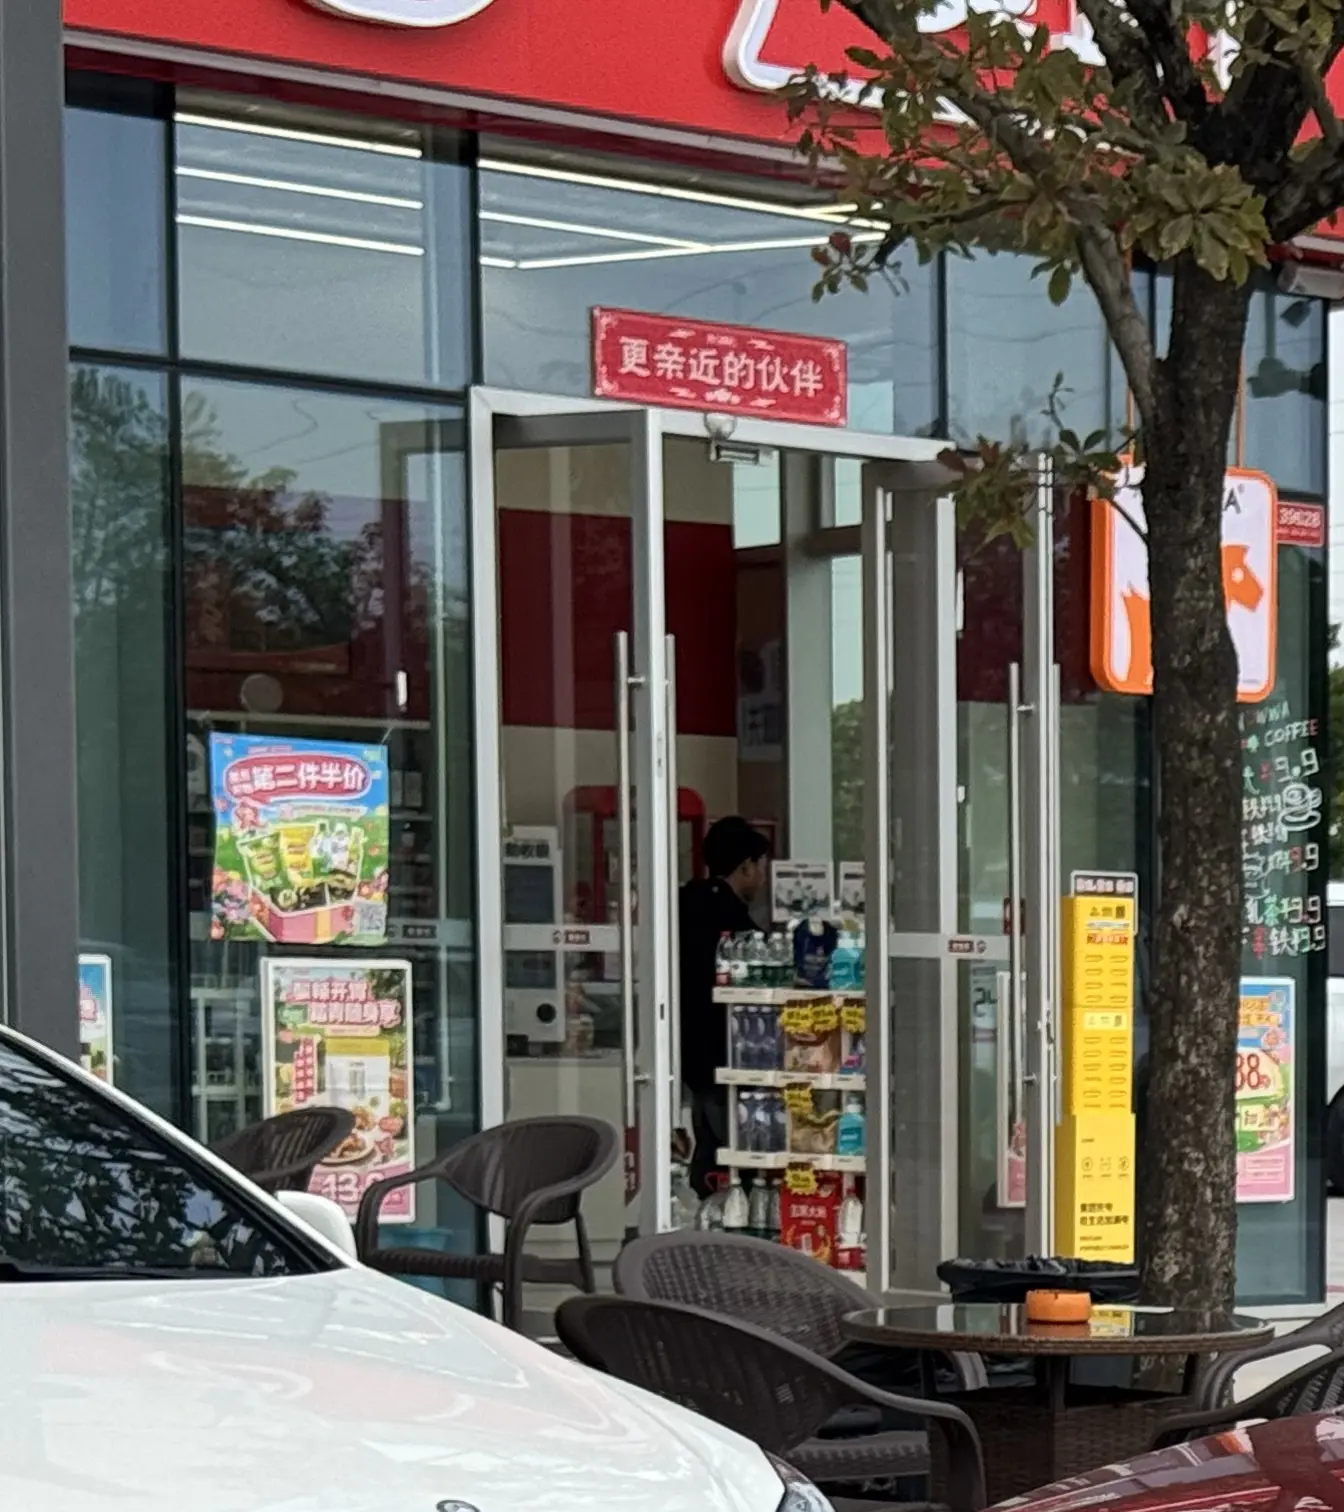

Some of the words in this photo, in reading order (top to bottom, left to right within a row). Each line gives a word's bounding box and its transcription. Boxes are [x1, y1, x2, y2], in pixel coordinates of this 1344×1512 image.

[619, 336, 824, 397] 更亲近的伙伴
[1264, 718, 1318, 747] COFFEE
